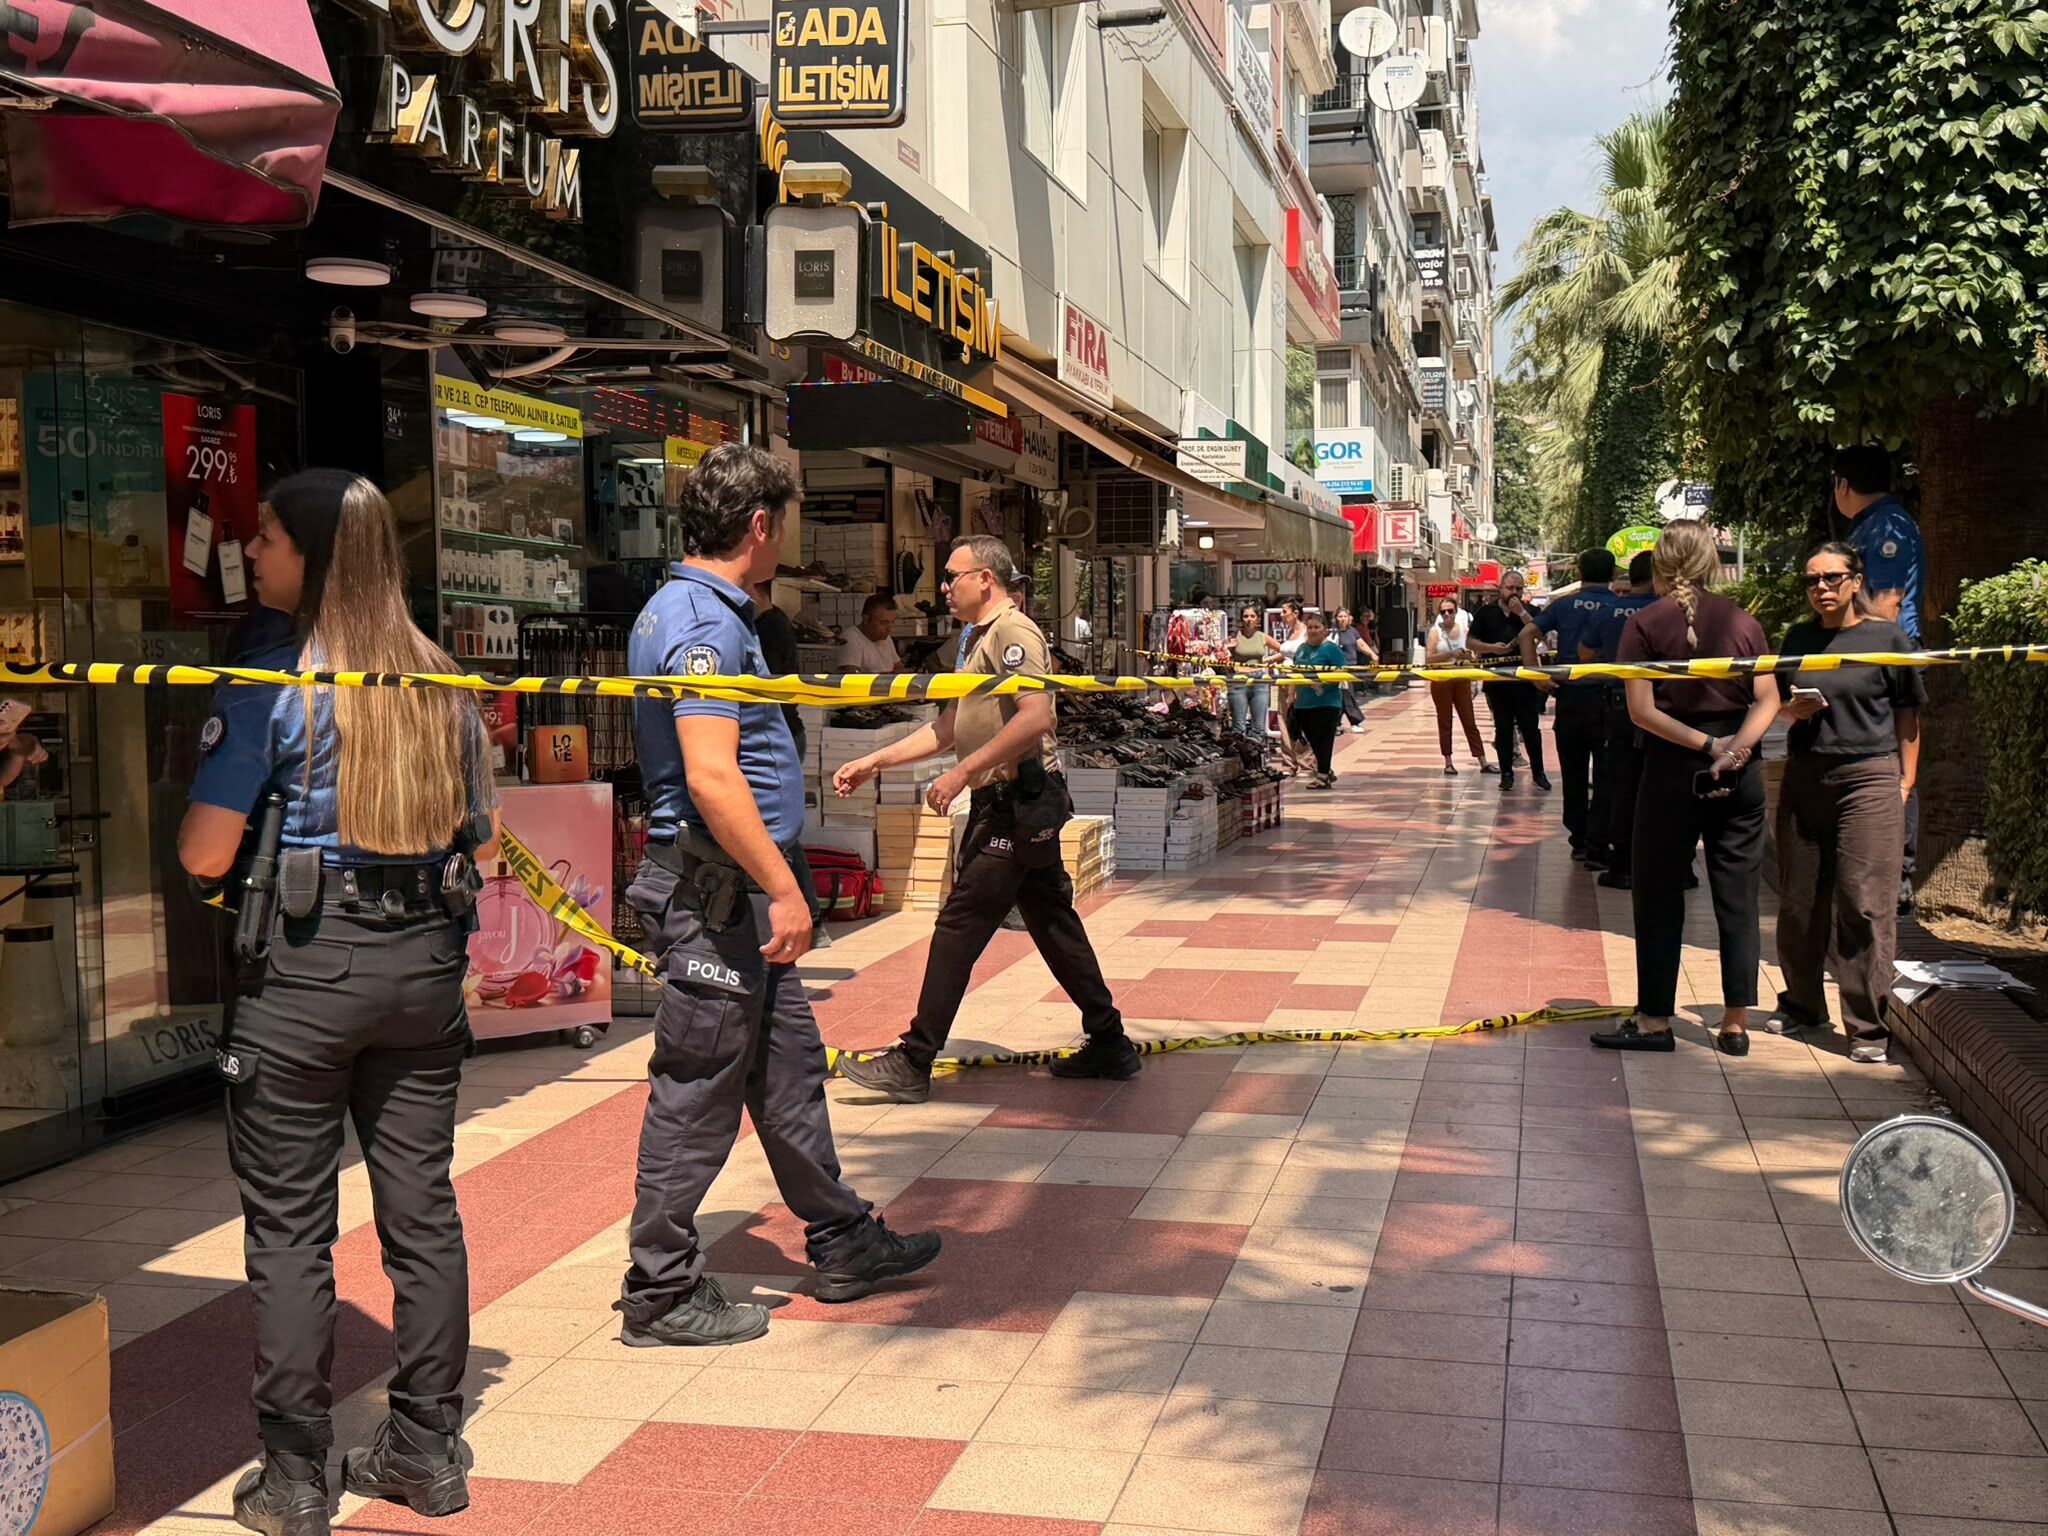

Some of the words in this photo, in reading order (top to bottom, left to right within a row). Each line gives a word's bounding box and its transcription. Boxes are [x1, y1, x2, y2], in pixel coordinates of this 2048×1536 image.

[797, 6, 888, 46] ADA
[778, 56, 889, 109] İLETİŞİM
[389, 61, 583, 220] PARFUM
[798, 261, 830, 273] LORIS
[880, 201, 1001, 365] İLETİŞİM
[197, 404, 222, 421] LORIS
[475, 393, 489, 409] CEP
[490, 397, 526, 418] TELEFONU
[36, 425, 98, 459] 50
[1391, 517, 1408, 540] E
[686, 959, 742, 987] POLİS
[139, 1018, 218, 1067] LORIS
